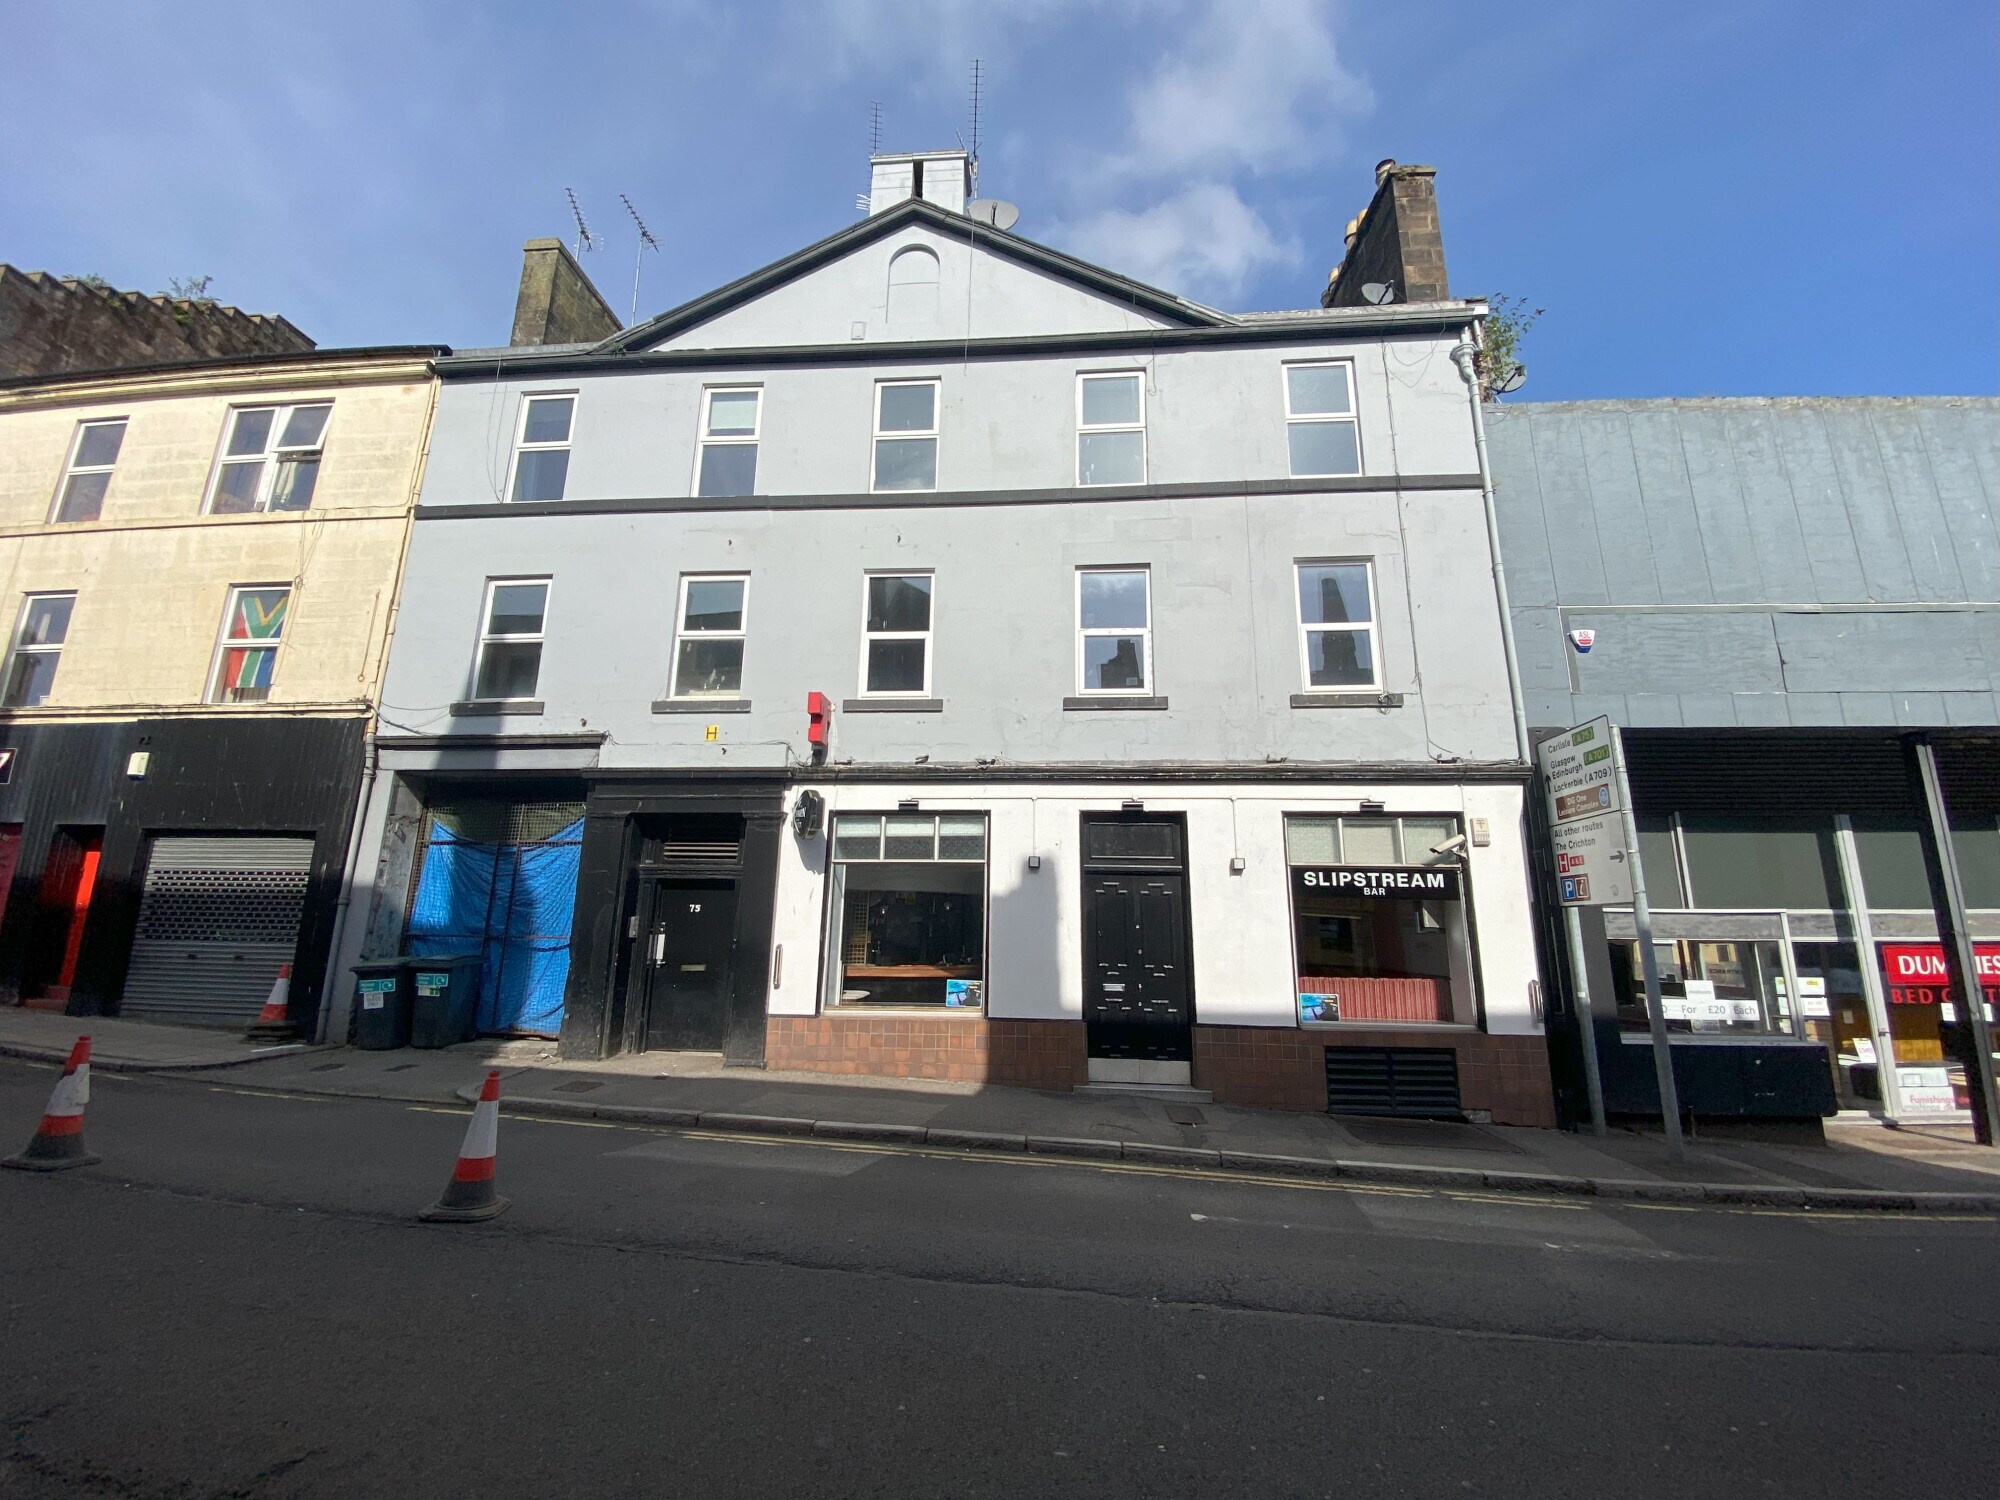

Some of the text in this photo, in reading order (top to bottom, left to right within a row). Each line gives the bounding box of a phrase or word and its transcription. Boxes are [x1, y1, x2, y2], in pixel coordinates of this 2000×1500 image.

[1548, 740, 1570, 753] Carlisle
[1551, 755, 1576, 769] Glasgow
[1552, 763, 1583, 780] Edinburgh
[1554, 766, 1612, 792] Lockerbie (A709)
[1567, 797, 1576, 806] DG
[1558, 801, 1599, 817] Leisure Complex
[1555, 822, 1603, 837] All other routes
[1556, 838, 1596, 851] The Crichton
[1558, 854, 1569, 872] H
[1303, 871, 1445, 888] SLIPSTREAM
[1363, 887, 1386, 896] BAR
[690, 904, 701, 913] 75
[1890, 988, 1934, 1004] BED
[1681, 1005, 1697, 1015] For
[1734, 1005, 1756, 1015] Each
